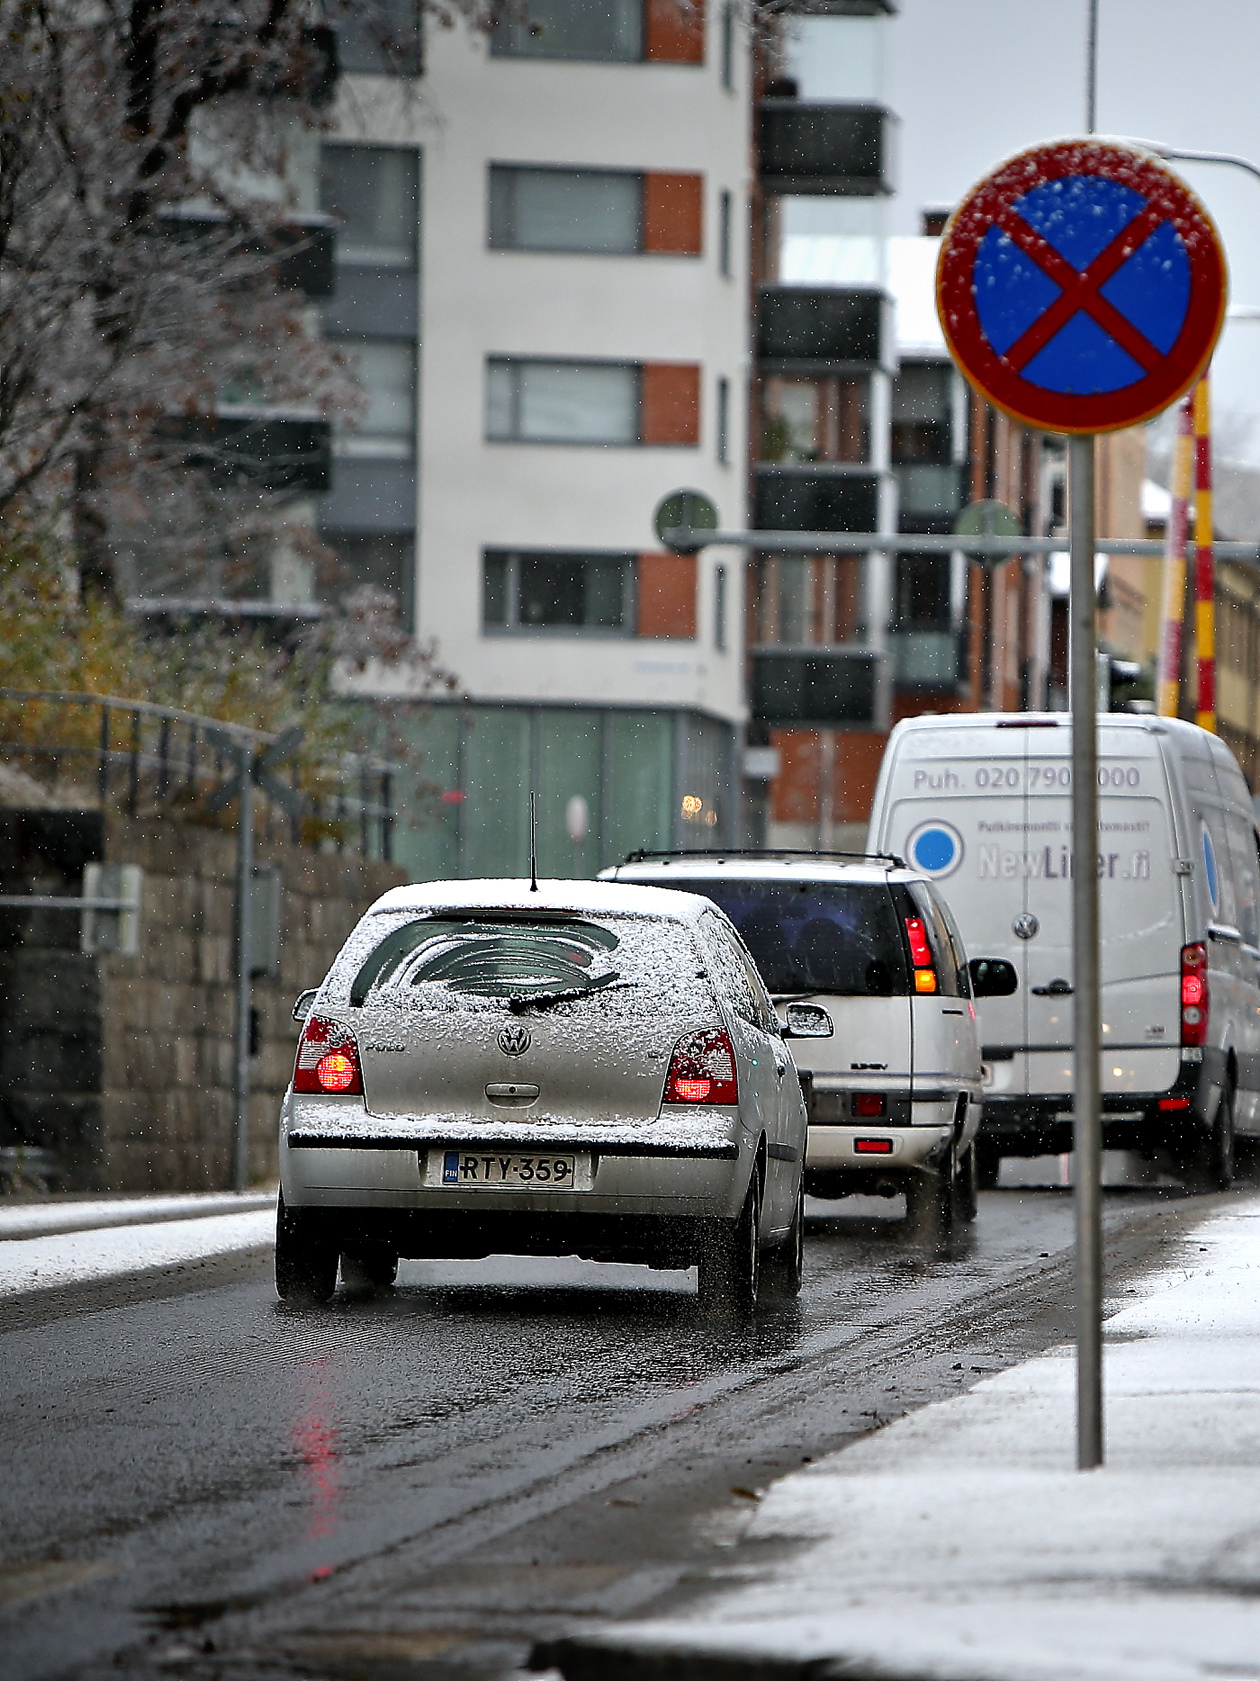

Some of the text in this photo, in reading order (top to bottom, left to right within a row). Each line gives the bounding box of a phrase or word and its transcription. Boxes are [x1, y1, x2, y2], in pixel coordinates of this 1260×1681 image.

[914, 767, 966, 789] Puh.
[975, 767, 1020, 787] 020
[461, 1156, 569, 1182] RTY-359
